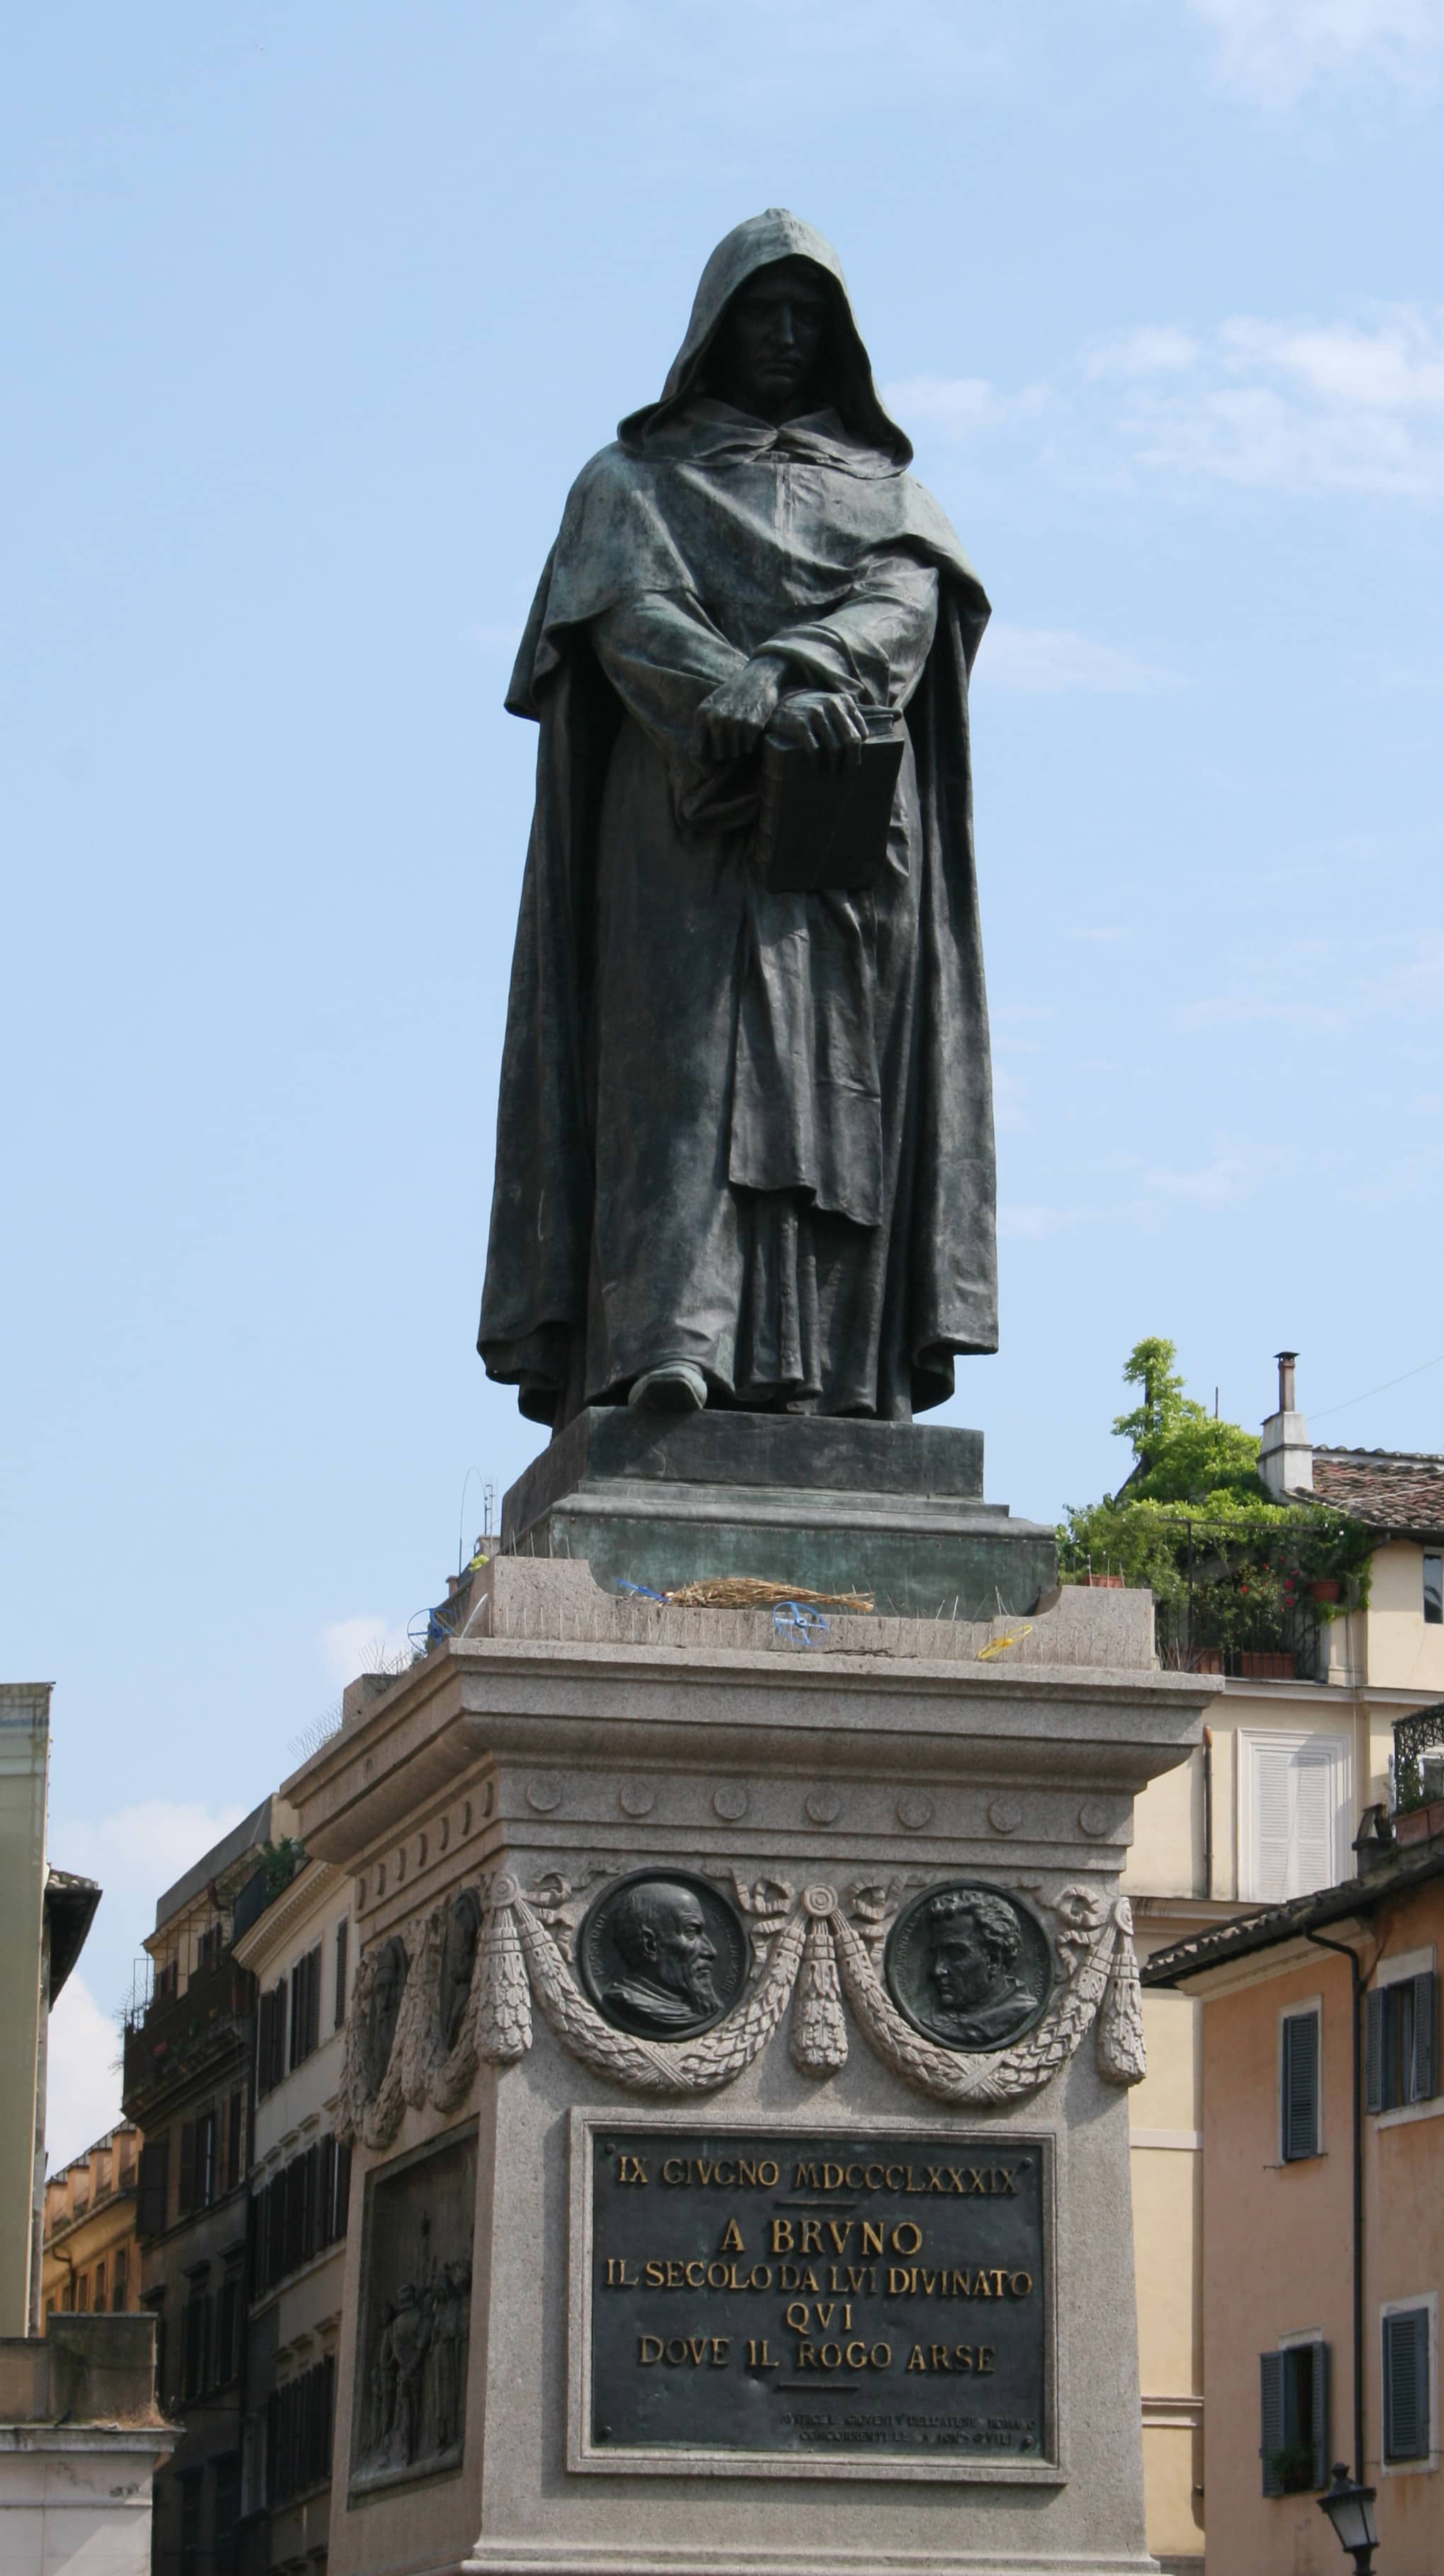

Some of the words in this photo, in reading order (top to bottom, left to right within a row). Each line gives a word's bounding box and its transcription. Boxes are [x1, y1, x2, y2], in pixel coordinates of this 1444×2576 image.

[619, 2156, 648, 2183] IX
[663, 2158, 779, 2185] GIVGNO
[794, 2162, 1017, 2192] MDCCCLXXXIX
[719, 2217, 745, 2251] A
[770, 2219, 922, 2255] BRVNO
[607, 2258, 638, 2286] IL
[646, 2260, 772, 2289] SECOLO
[780, 2265, 819, 2292] DA
[830, 2266, 878, 2293] LVI
[889, 2267, 1033, 2297] DIVINATO
[786, 2302, 852, 2335] QVI
[639, 2335, 729, 2365] DOVE
[748, 2340, 779, 2367] IL
[797, 2341, 892, 2368] ROGO
[908, 2344, 996, 2371] ARSE
[987, 2417, 1036, 2432] ROMAO
